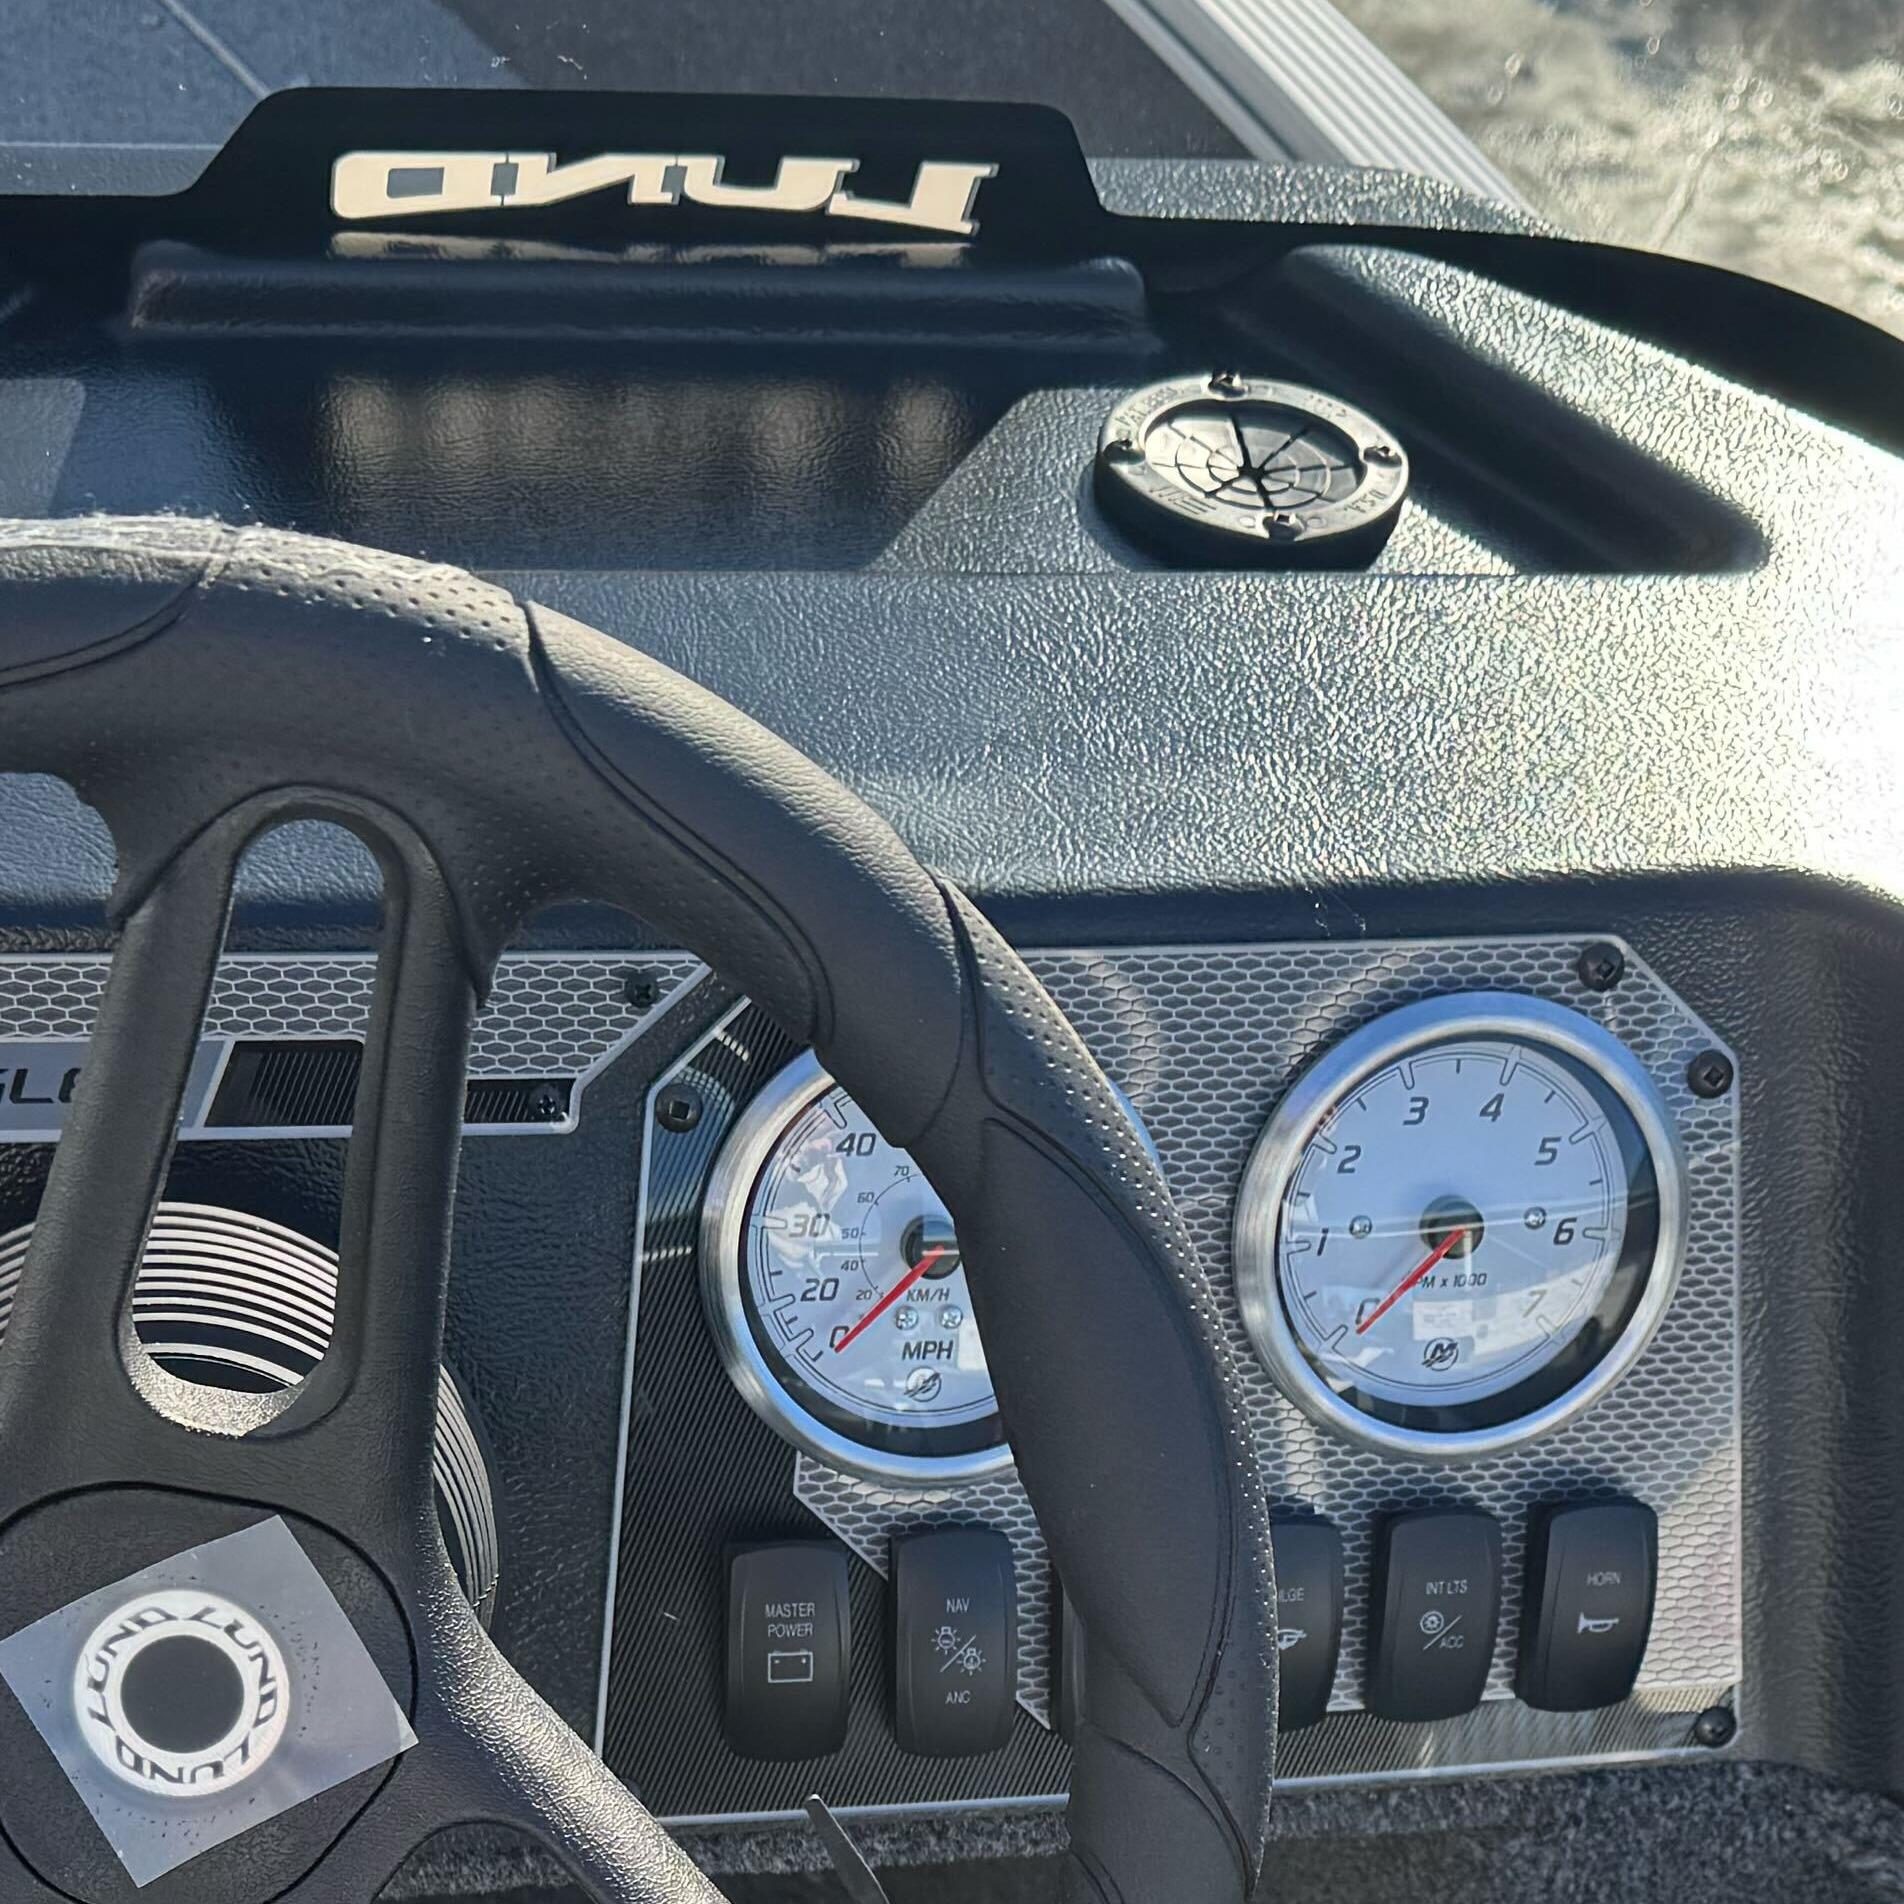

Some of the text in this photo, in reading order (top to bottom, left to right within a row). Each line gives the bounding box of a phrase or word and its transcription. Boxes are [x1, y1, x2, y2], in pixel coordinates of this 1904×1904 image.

[1402, 1096, 1429, 1126] 3
[1480, 1093, 1505, 1122] 4
[836, 1132, 877, 1157] 40
[1534, 1137, 1562, 1165] 5
[1337, 1144, 1362, 1174] 2
[789, 1213, 831, 1238] 30
[1553, 1217, 1578, 1245] 6
[1316, 1228, 1330, 1256] 1
[800, 1278, 840, 1302] 20
[906, 1288, 951, 1302] KM/H
[1522, 1289, 1548, 1319] 7
[902, 1340, 954, 1361] MPH
[765, 1602, 816, 1618] MASTER
[946, 1598, 970, 1613] NAV
[767, 1623, 814, 1638] POWER
[86, 1606, 179, 1731] LUND
[183, 1606, 277, 1729] LUND
[114, 1731, 251, 1784] LUND
